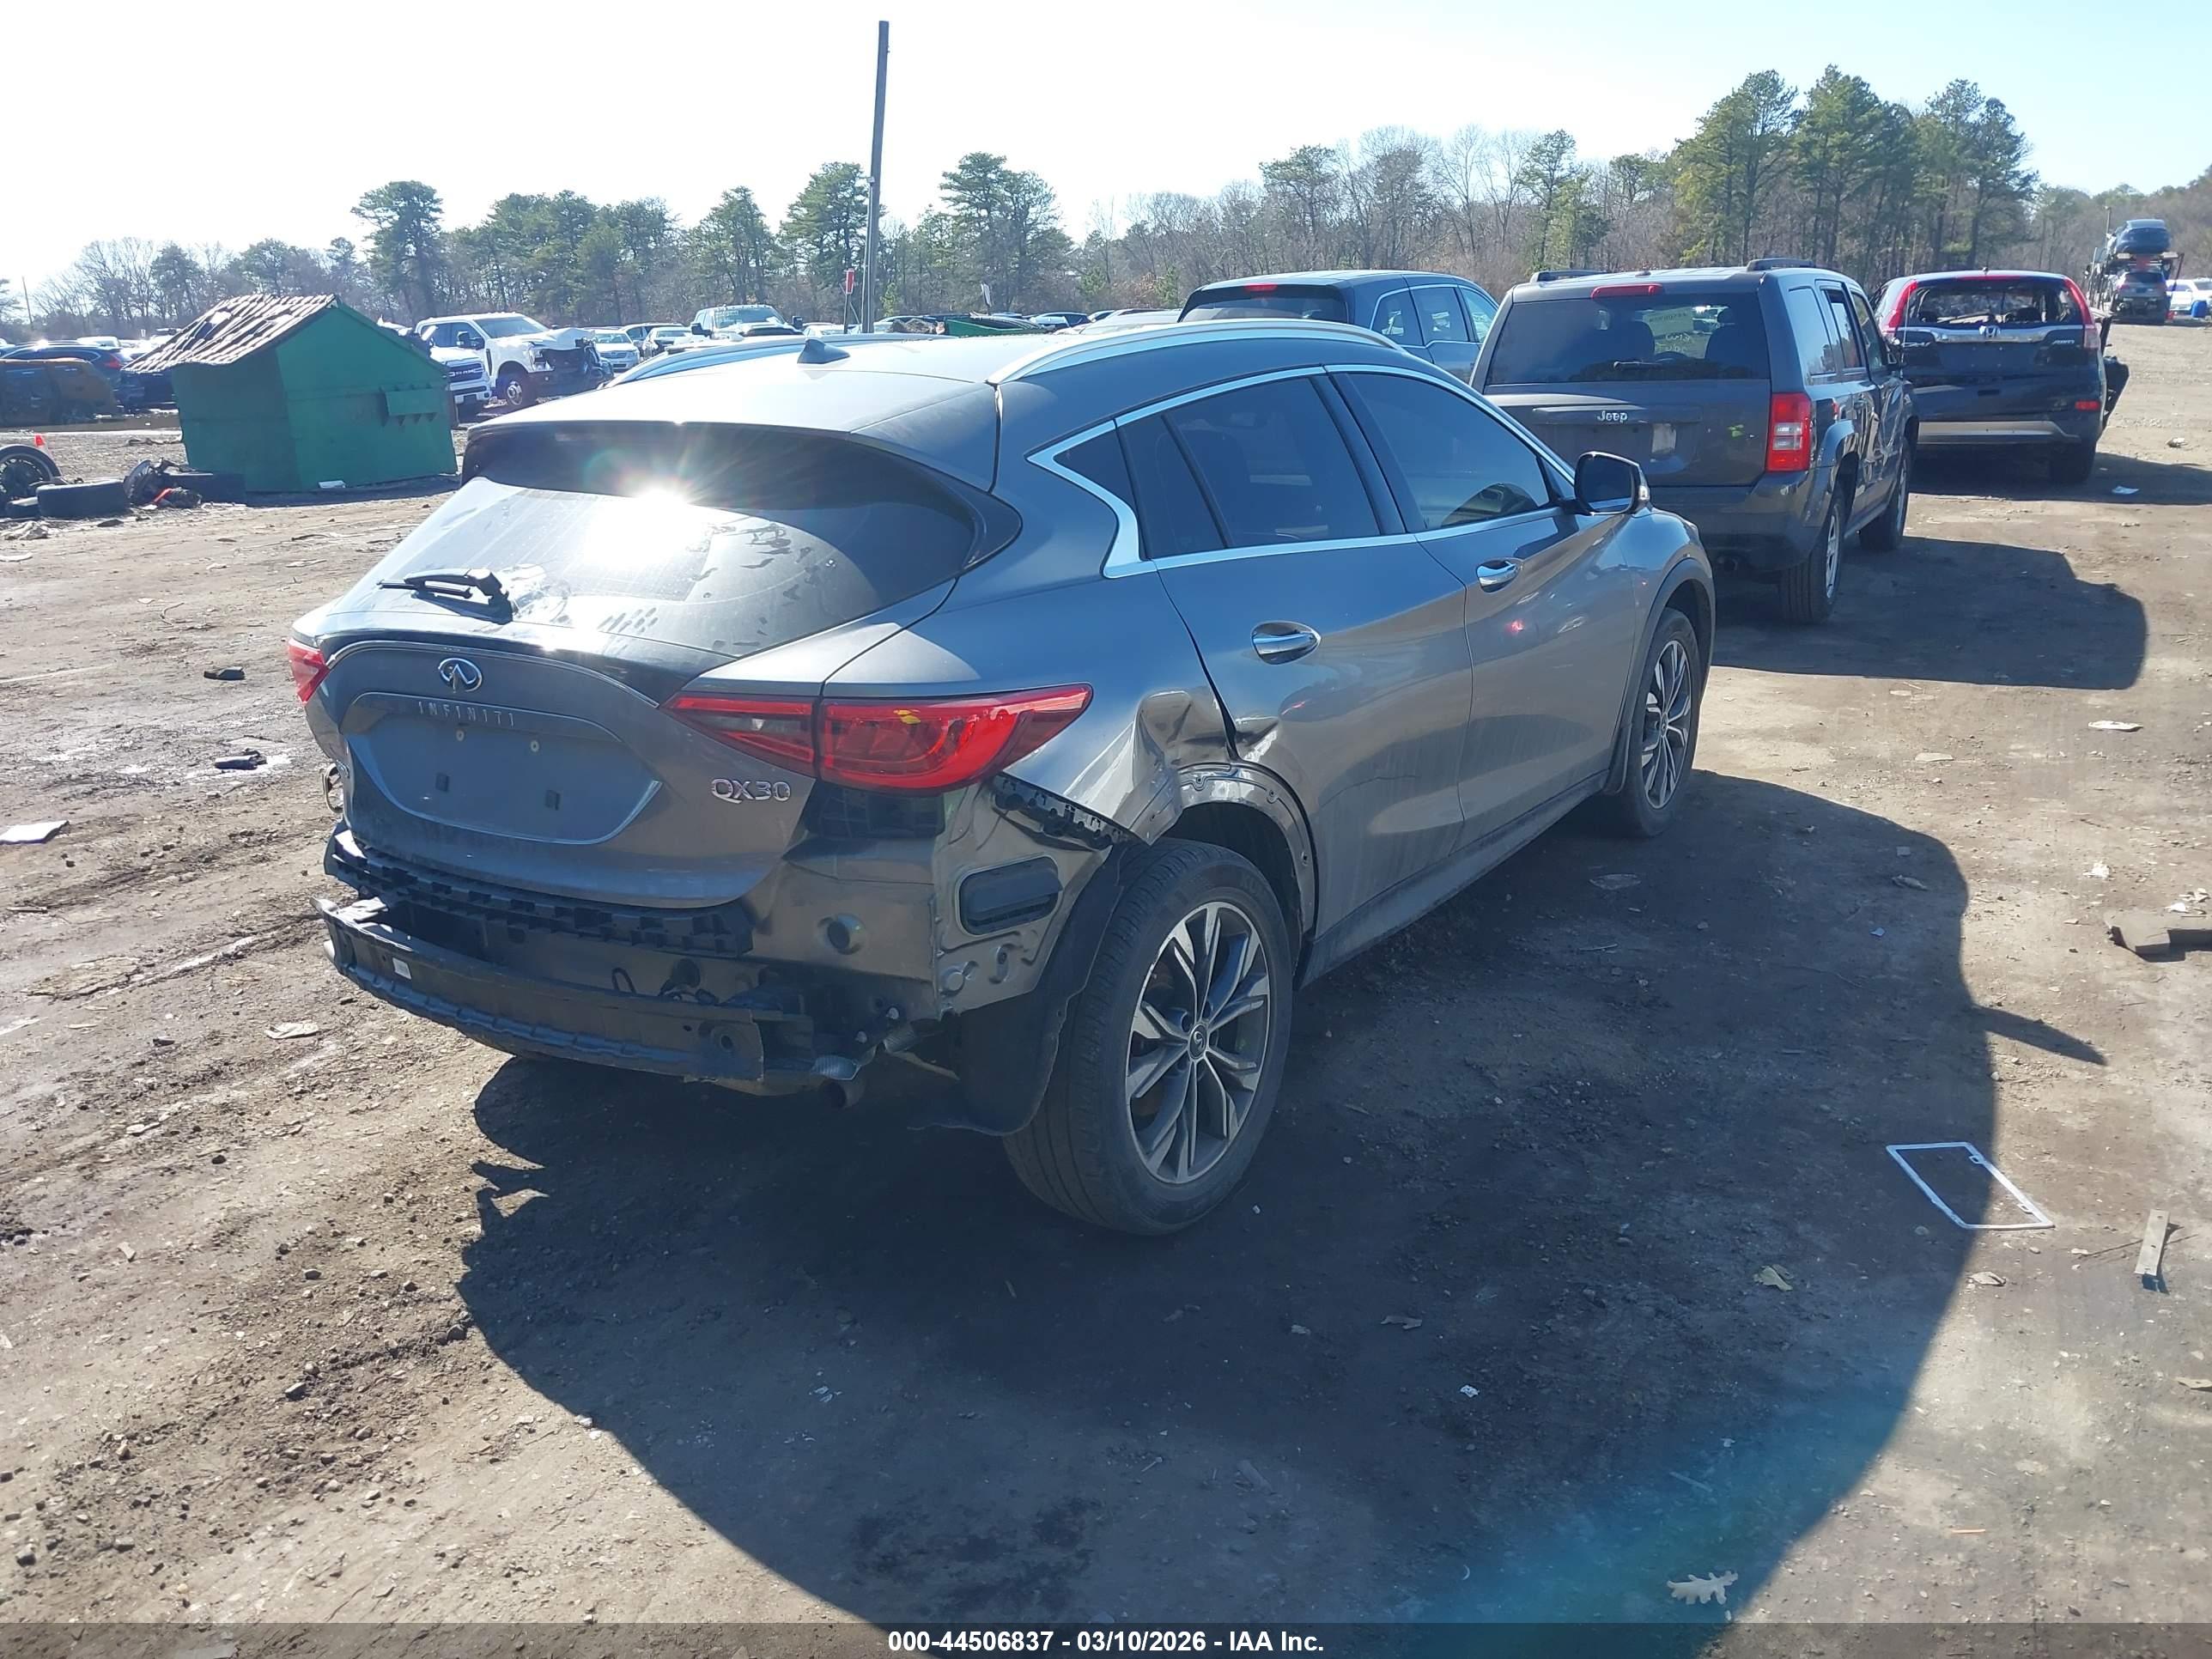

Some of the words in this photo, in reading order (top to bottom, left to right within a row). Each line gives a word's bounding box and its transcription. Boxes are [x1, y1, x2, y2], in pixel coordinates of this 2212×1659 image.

[1596, 410, 1628, 424] Jeep
[418, 701, 515, 728] INFINITI
[710, 778, 792, 804] QX30
